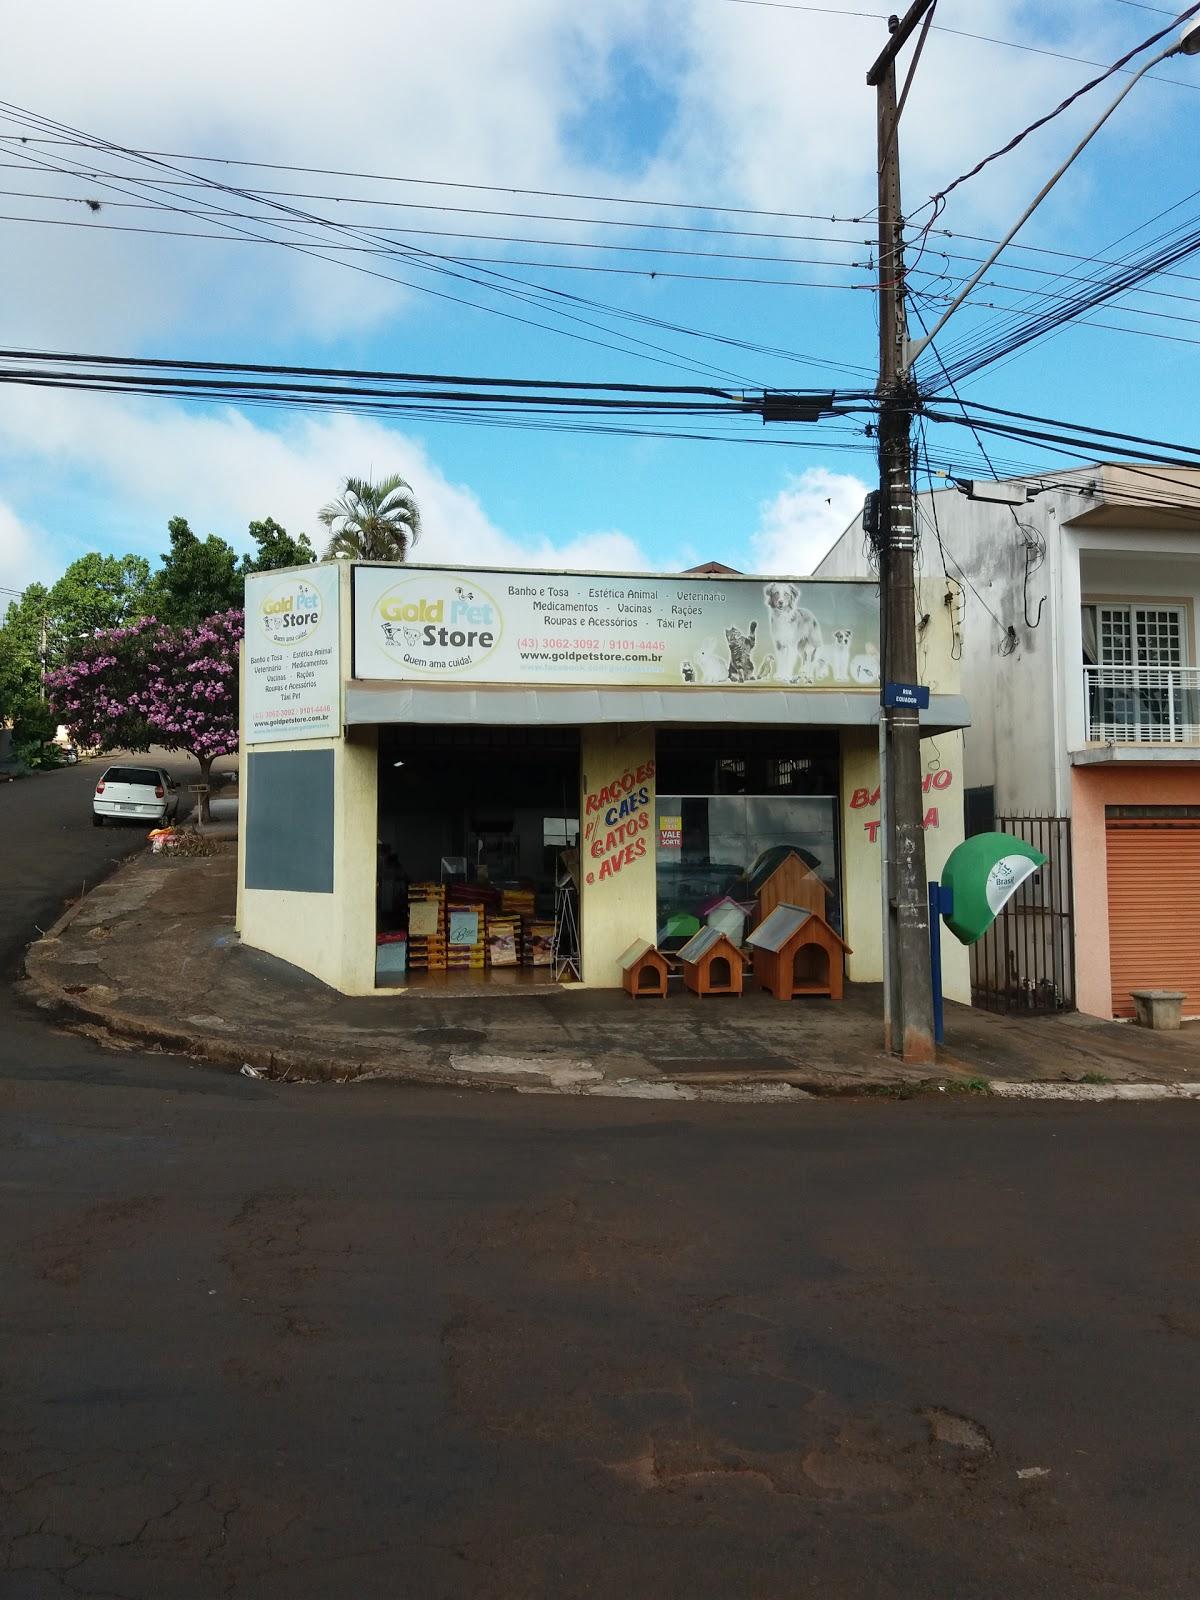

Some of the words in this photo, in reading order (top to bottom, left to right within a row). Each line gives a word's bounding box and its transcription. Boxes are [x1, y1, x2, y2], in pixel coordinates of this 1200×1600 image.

[508, 586, 537, 596] Banho
[540, 588, 545, 596] e
[548, 587, 569, 597] Tosa
[588, 588, 625, 599] Estética
[627, 589, 658, 600] Animal
[263, 595, 293, 615] Gold
[297, 593, 318, 609] Pet
[380, 598, 444, 623] Gold
[450, 600, 493, 625] Pet
[533, 601, 599, 612] Medicamentos
[617, 603, 652, 614] Vacinas
[671, 604, 703, 617] Rações
[283, 612, 318, 628] Store
[544, 616, 577, 626] Roupas
[580, 618, 586, 626] e
[588, 617, 638, 628] Acessórios
[657, 618, 675, 629] Táxi
[677, 619, 693, 629] Pet
[423, 625, 494, 648] Store
[517, 638, 539, 650] (43)
[542, 639, 600, 650] 3062-3092
[608, 640, 666, 651] 9101-4446
[251, 656, 265, 664] Banho
[272, 654, 283, 662] Tosa
[293, 650, 313, 659] Estética
[314, 647, 332, 656] Animal
[403, 653, 427, 667] Quem
[429, 660, 446, 668] ama
[448, 655, 473, 668] cuida!
[520, 651, 663, 662] www.goldpetstore.com.br
[292, 659, 328, 669] Medicamentos
[297, 670, 315, 680] Rações
[289, 681, 317, 690] Acessórios
[254, 714, 329, 728] www.goldpetstore.com.br
[585, 760, 655, 816] RAÇÕES
[605, 787, 649, 827] CÃES
[591, 812, 649, 859] GATOS
[661, 830, 681, 839] VALE
[586, 872, 595, 886] e
[598, 837, 647, 882] AVES
